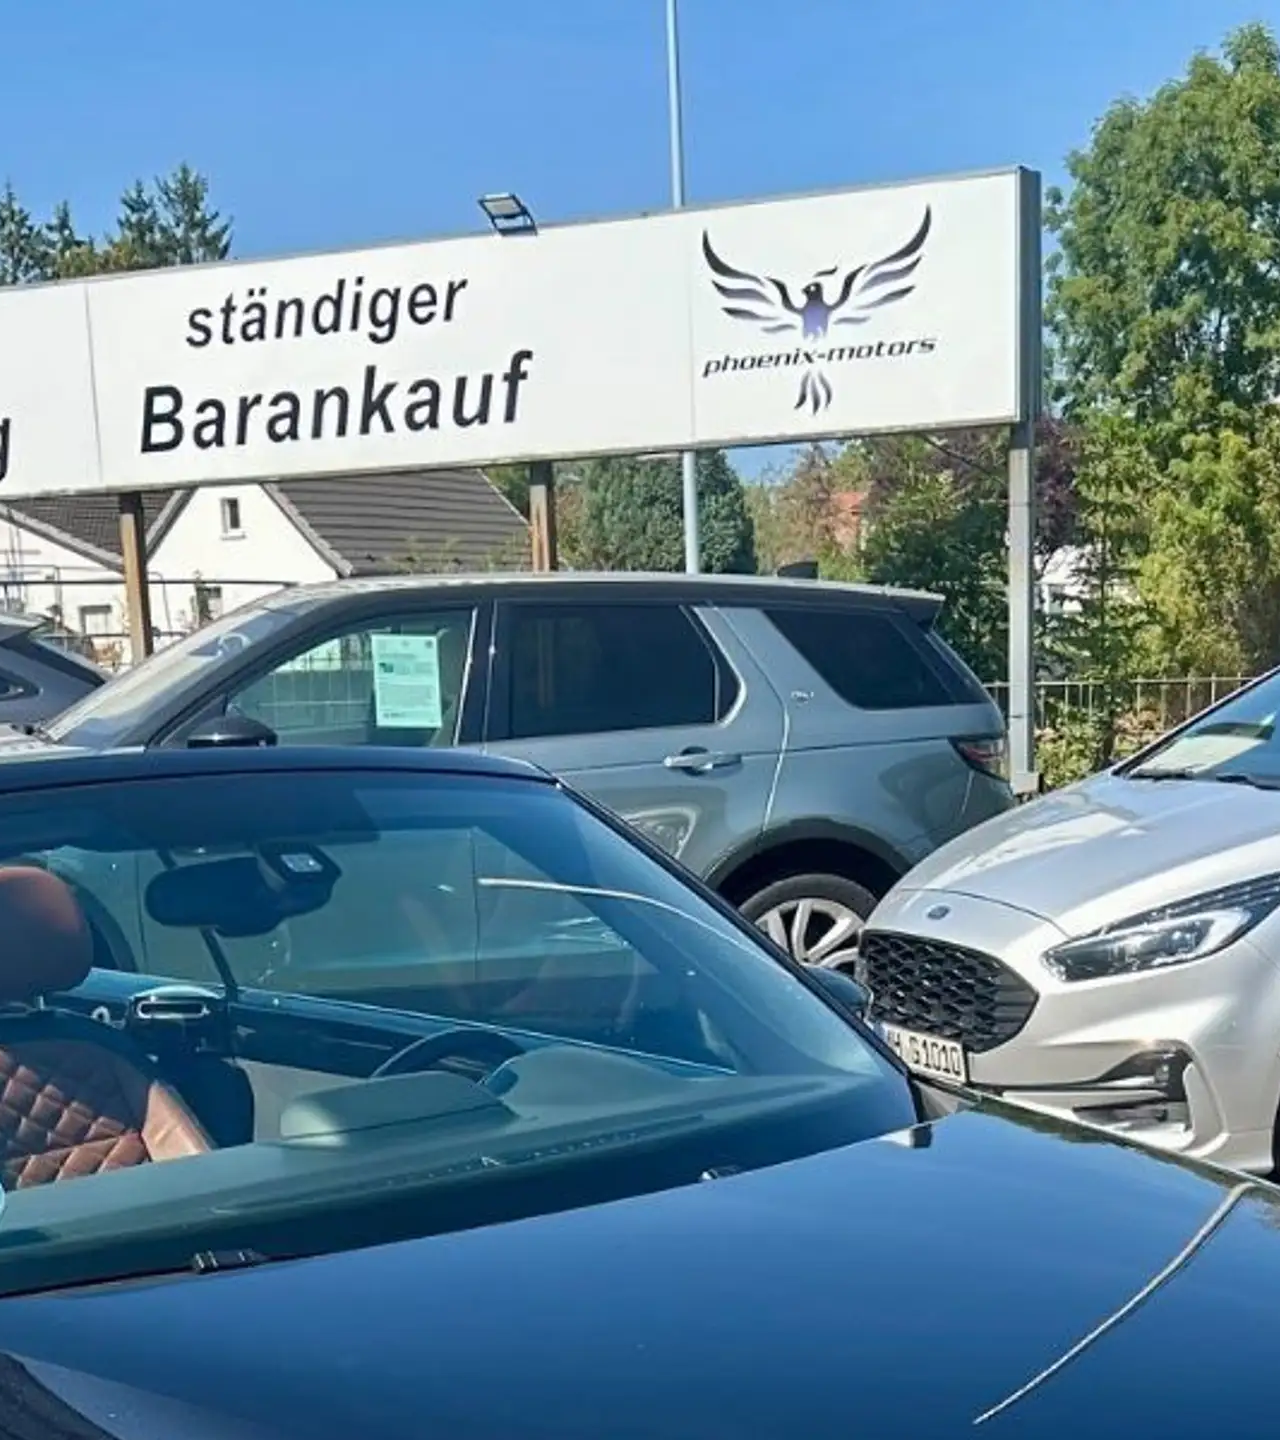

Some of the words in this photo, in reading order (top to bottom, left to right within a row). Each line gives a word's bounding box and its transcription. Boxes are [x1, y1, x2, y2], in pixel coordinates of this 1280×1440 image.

[186, 277, 468, 348] ständiger
[696, 337, 937, 378] phoenix-motors
[140, 351, 533, 454] Barankauf
